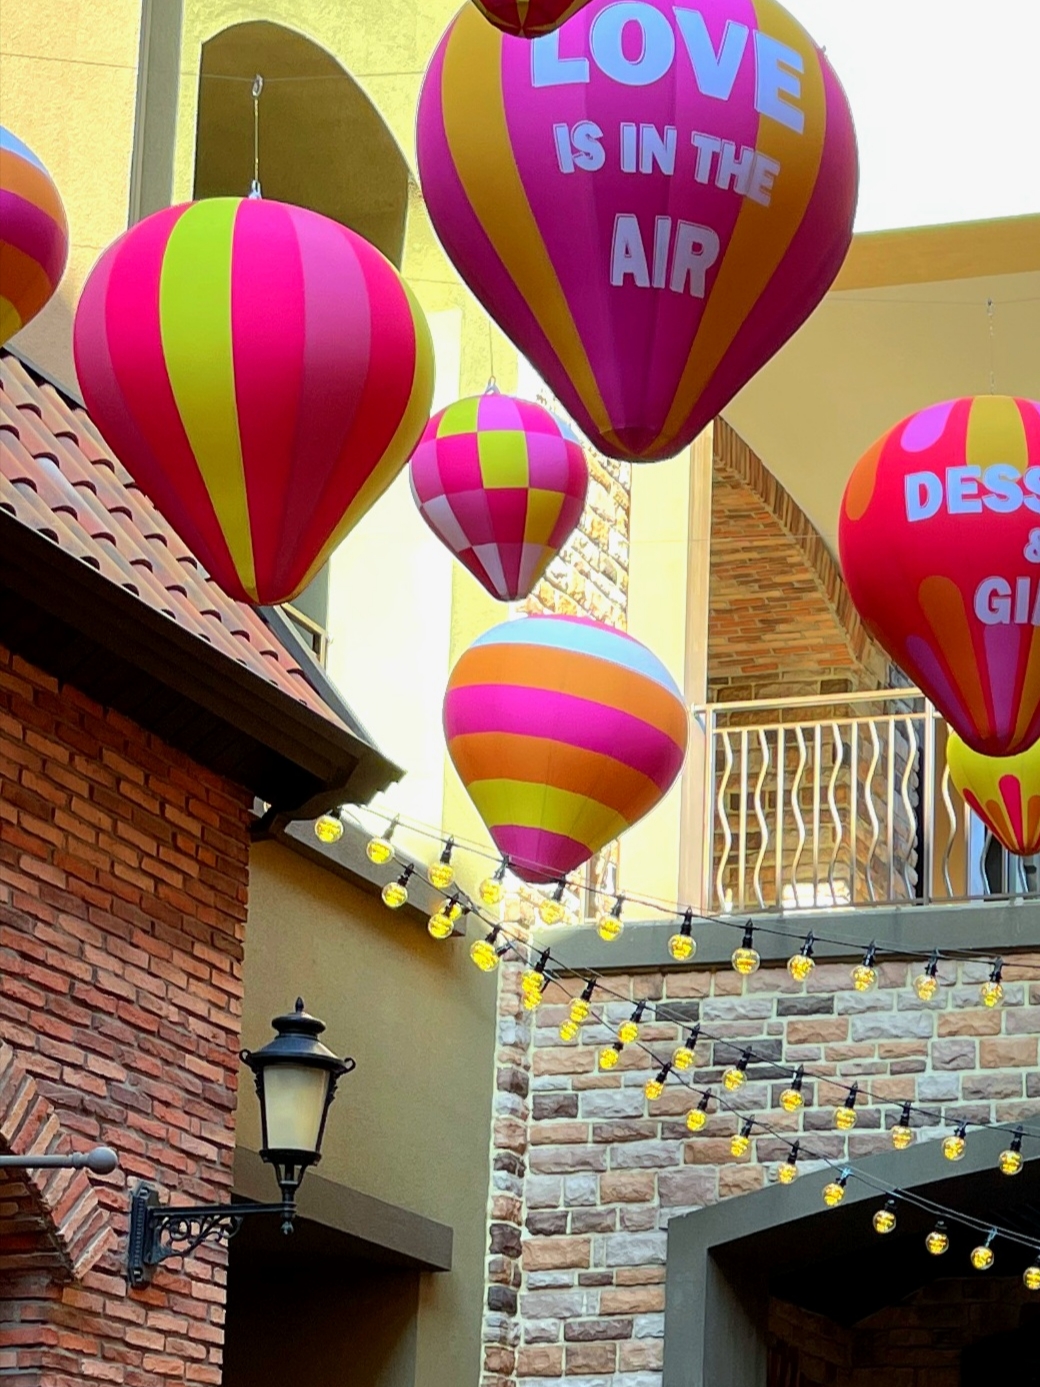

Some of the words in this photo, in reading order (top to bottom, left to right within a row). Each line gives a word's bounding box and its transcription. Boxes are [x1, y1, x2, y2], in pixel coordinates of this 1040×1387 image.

[530, 1, 805, 135] LOVE
[552, 120, 606, 174] IS
[620, 121, 677, 176] IN
[690, 130, 781, 208] THE
[610, 213, 720, 299] AIR
